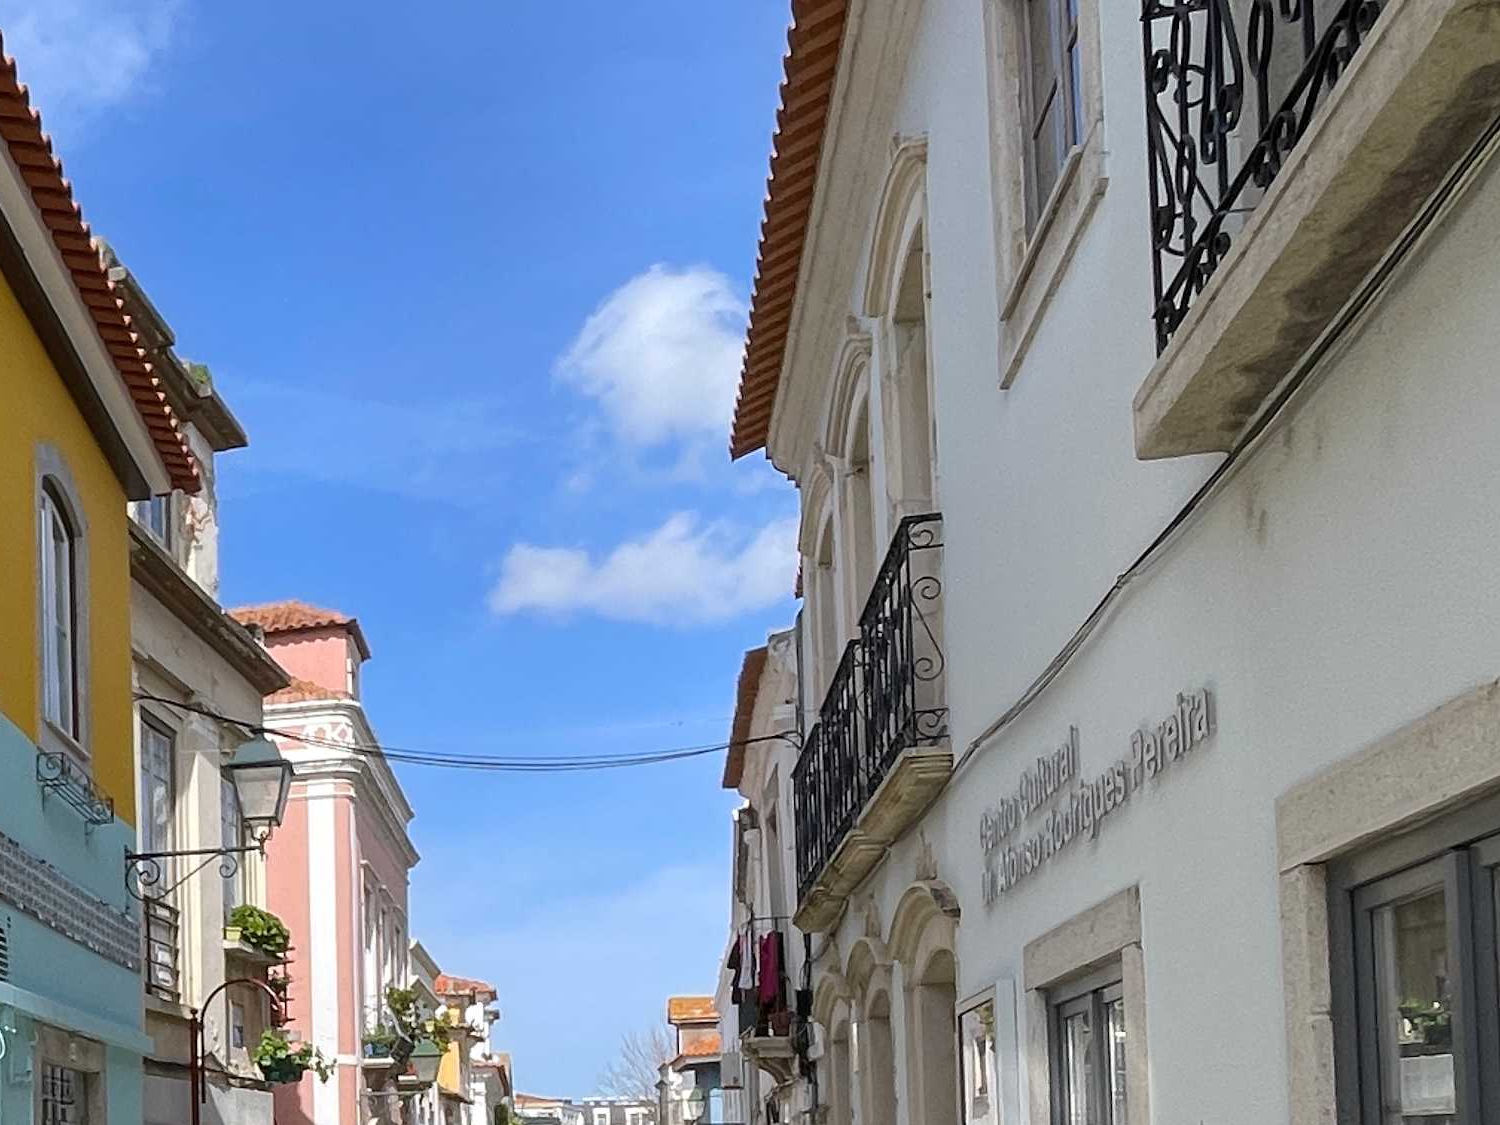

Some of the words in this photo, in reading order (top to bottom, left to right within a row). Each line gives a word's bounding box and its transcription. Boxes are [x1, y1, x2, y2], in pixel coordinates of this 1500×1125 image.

[997, 834, 1042, 897] Afonso
[1042, 759, 1128, 860] Rodrigues
[1129, 687, 1211, 792] Pereira
[1019, 722, 1078, 820] Cultural
